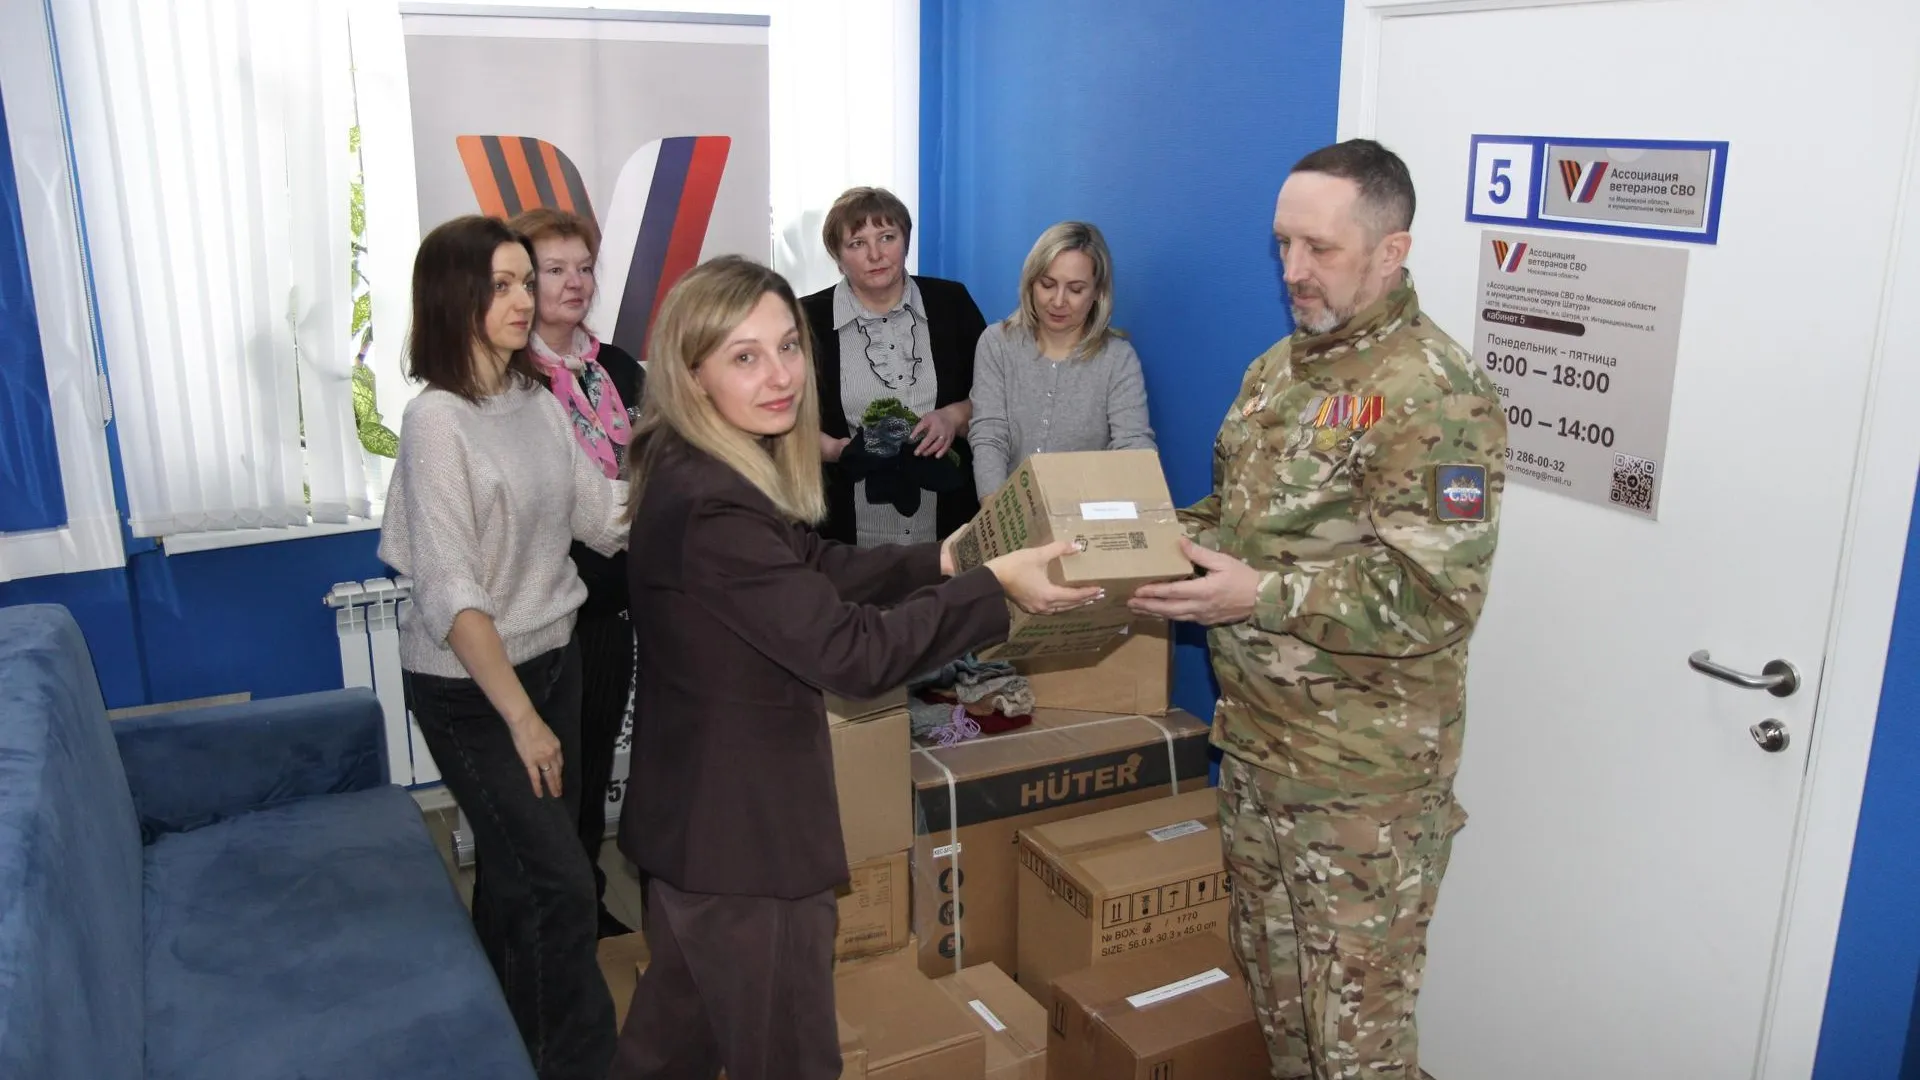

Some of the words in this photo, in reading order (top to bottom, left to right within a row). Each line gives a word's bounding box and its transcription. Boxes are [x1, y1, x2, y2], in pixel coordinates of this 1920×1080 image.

[1488, 158, 1512, 204] 5
[1609, 183, 1668, 195] ветеранов
[1670, 184, 1696, 196] СВО
[1611, 168, 1679, 182] Ассоциация
[1528, 258, 1568, 270] ветеранов
[1569, 262, 1588, 272] СВО
[1529, 248, 1576, 261] Ассоциация
[1491, 291, 1540, 303] муниципальном
[1540, 298, 1561, 308] округе
[1562, 299, 1591, 312] Шатура»
[1527, 287, 1560, 298] ветеранов
[1560, 290, 1576, 300] СВО
[1586, 294, 1626, 309] Московской
[1627, 300, 1657, 312] области
[1486, 310, 1518, 324] кабинет
[1519, 315, 1526, 325] 5
[1487, 333, 1558, 356] Понедельник
[1569, 350, 1618, 367] пятница
[1486, 351, 1527, 377] 9:00
[1552, 364, 1610, 394] 18:00
[1557, 416, 1615, 448] 14:00
[1504, 447, 1514, 461] 5)
[1516, 450, 1566, 473] 286-00-32
[1505, 463, 1572, 487] vo.mosreg@mail.ru
[1001, 490, 1012, 516] the
[1009, 518, 1023, 550] worl
[1008, 484, 1027, 541] making
[984, 510, 995, 538] find
[991, 541, 999, 557] ou
[997, 510, 1012, 553] clean
[1021, 758, 1140, 807] HÜTER
[1101, 943, 1126, 957] SIZE:
[1128, 937, 1147, 950] 56.0
[1184, 923, 1203, 935] 45.0
[1115, 927, 1138, 940] BOX:
[1177, 911, 1198, 923] 1770
